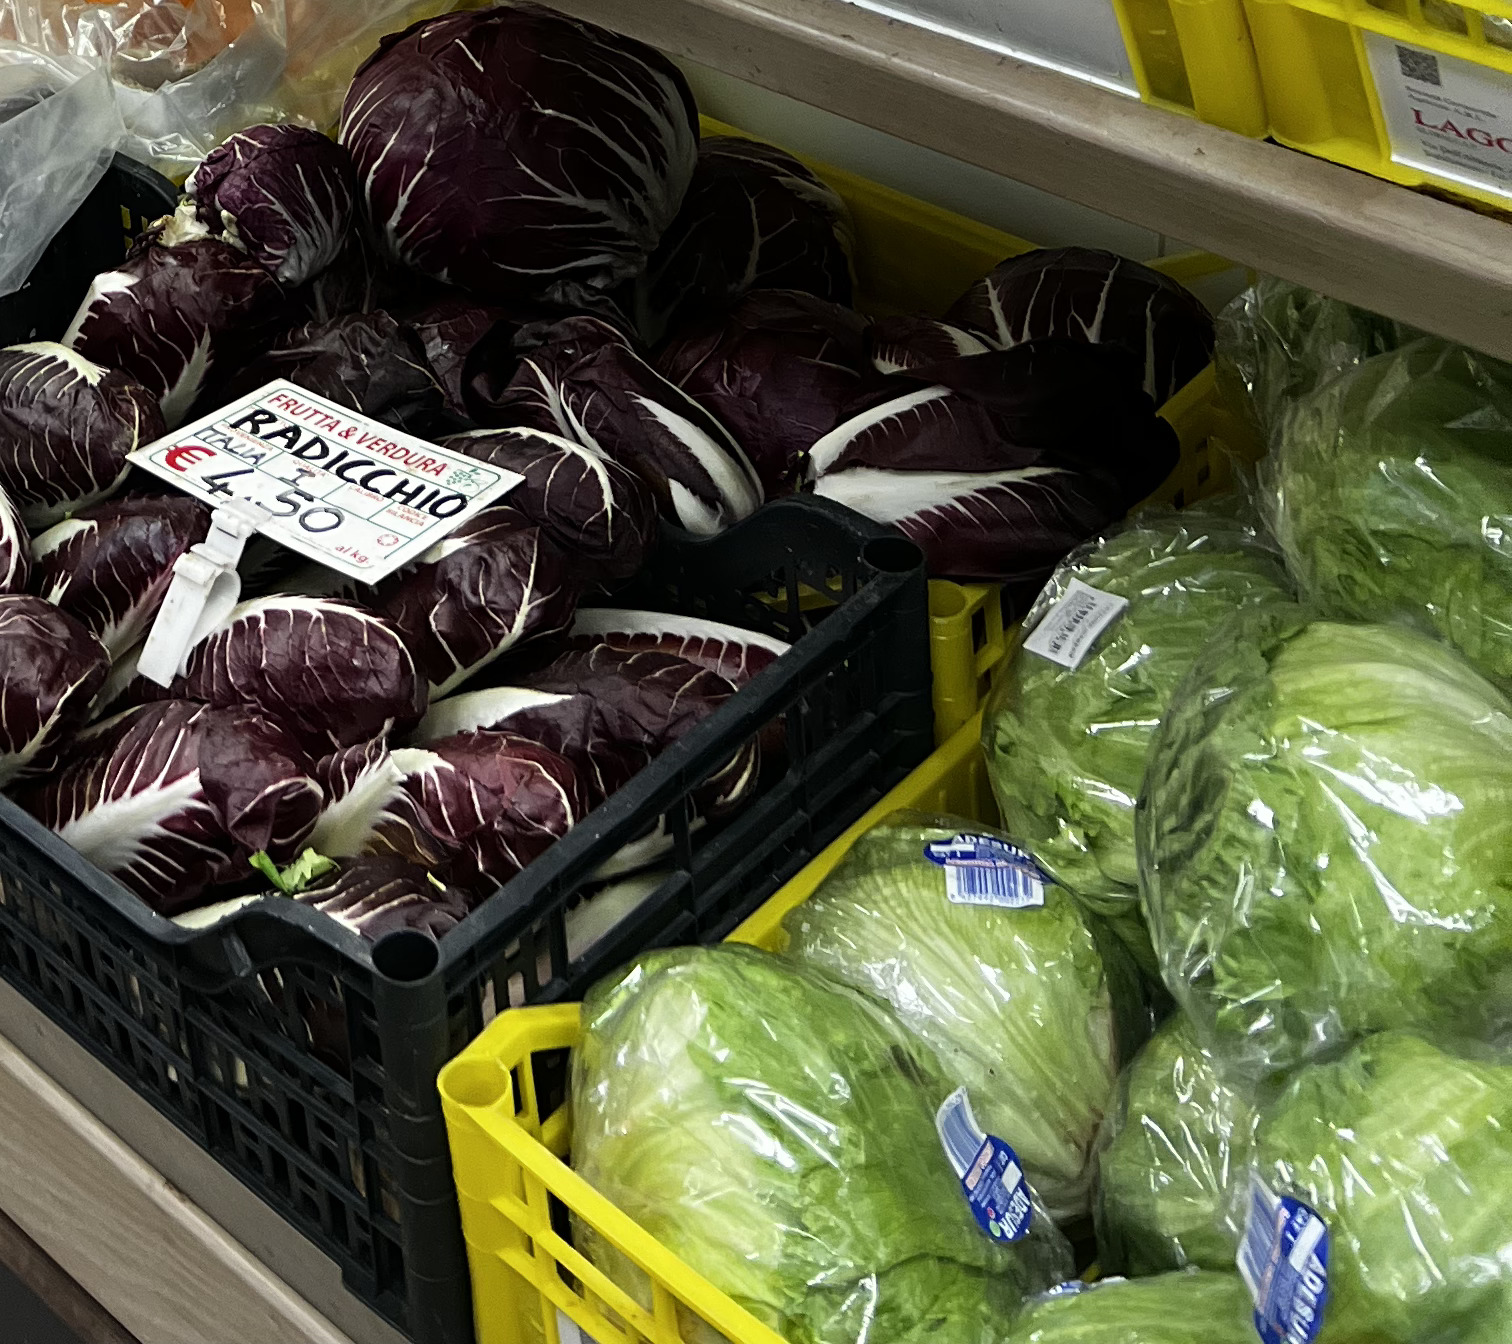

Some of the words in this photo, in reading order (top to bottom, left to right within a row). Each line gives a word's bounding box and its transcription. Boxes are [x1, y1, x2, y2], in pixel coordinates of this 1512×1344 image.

[193, 427, 266, 466] ITALIA
[229, 408, 468, 518] RADICCHIO
[267, 393, 345, 434] FRUTTA
[338, 425, 359, 443] &
[357, 432, 449, 477] VERDURA
[396, 502, 429, 521] CODICE
